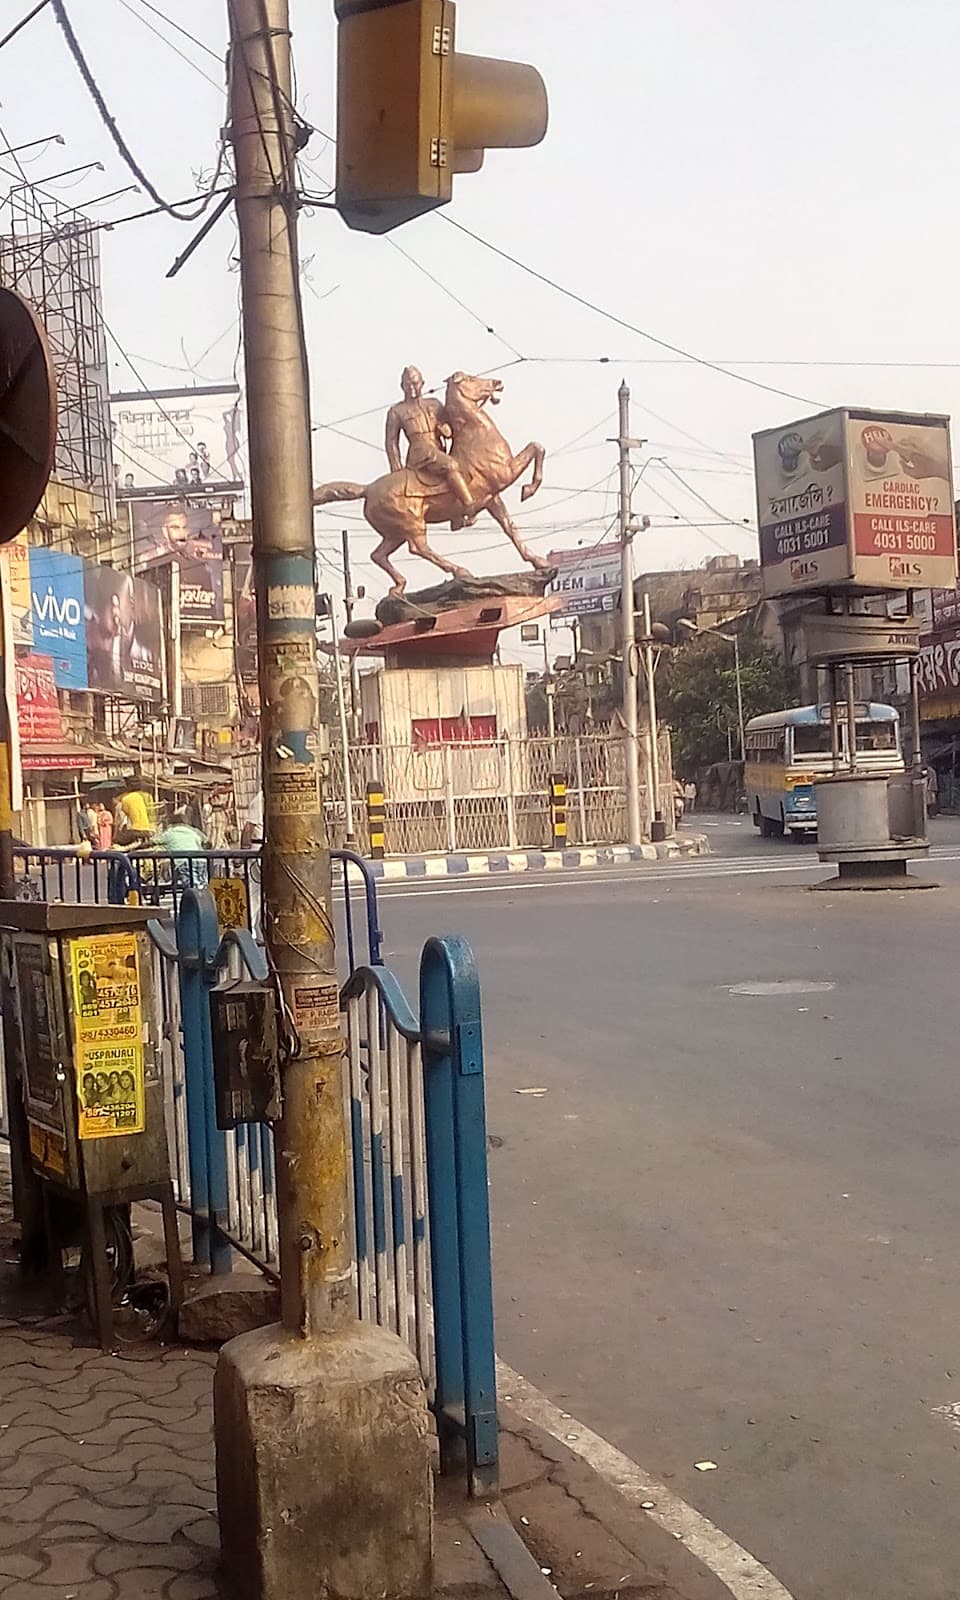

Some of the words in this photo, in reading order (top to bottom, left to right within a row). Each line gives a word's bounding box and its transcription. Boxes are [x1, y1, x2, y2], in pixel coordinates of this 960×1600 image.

[883, 481, 920, 494] CARDIAC
[865, 493, 939, 511] EMERGENCY?
[774, 523, 794, 540] CALL
[795, 514, 831, 535] ILS-CARE
[871, 518, 894, 531] CALL
[896, 519, 937, 533] ILS-CARE
[777, 536, 801, 555] 4031
[804, 529, 829, 549] 5001
[874, 533, 902, 549] 4031
[906, 535, 935, 550] 5000
[901, 563, 922, 575] ILS
[551, 576, 584, 592] UEM
[85, 1048, 134, 1060] USPANJALI
